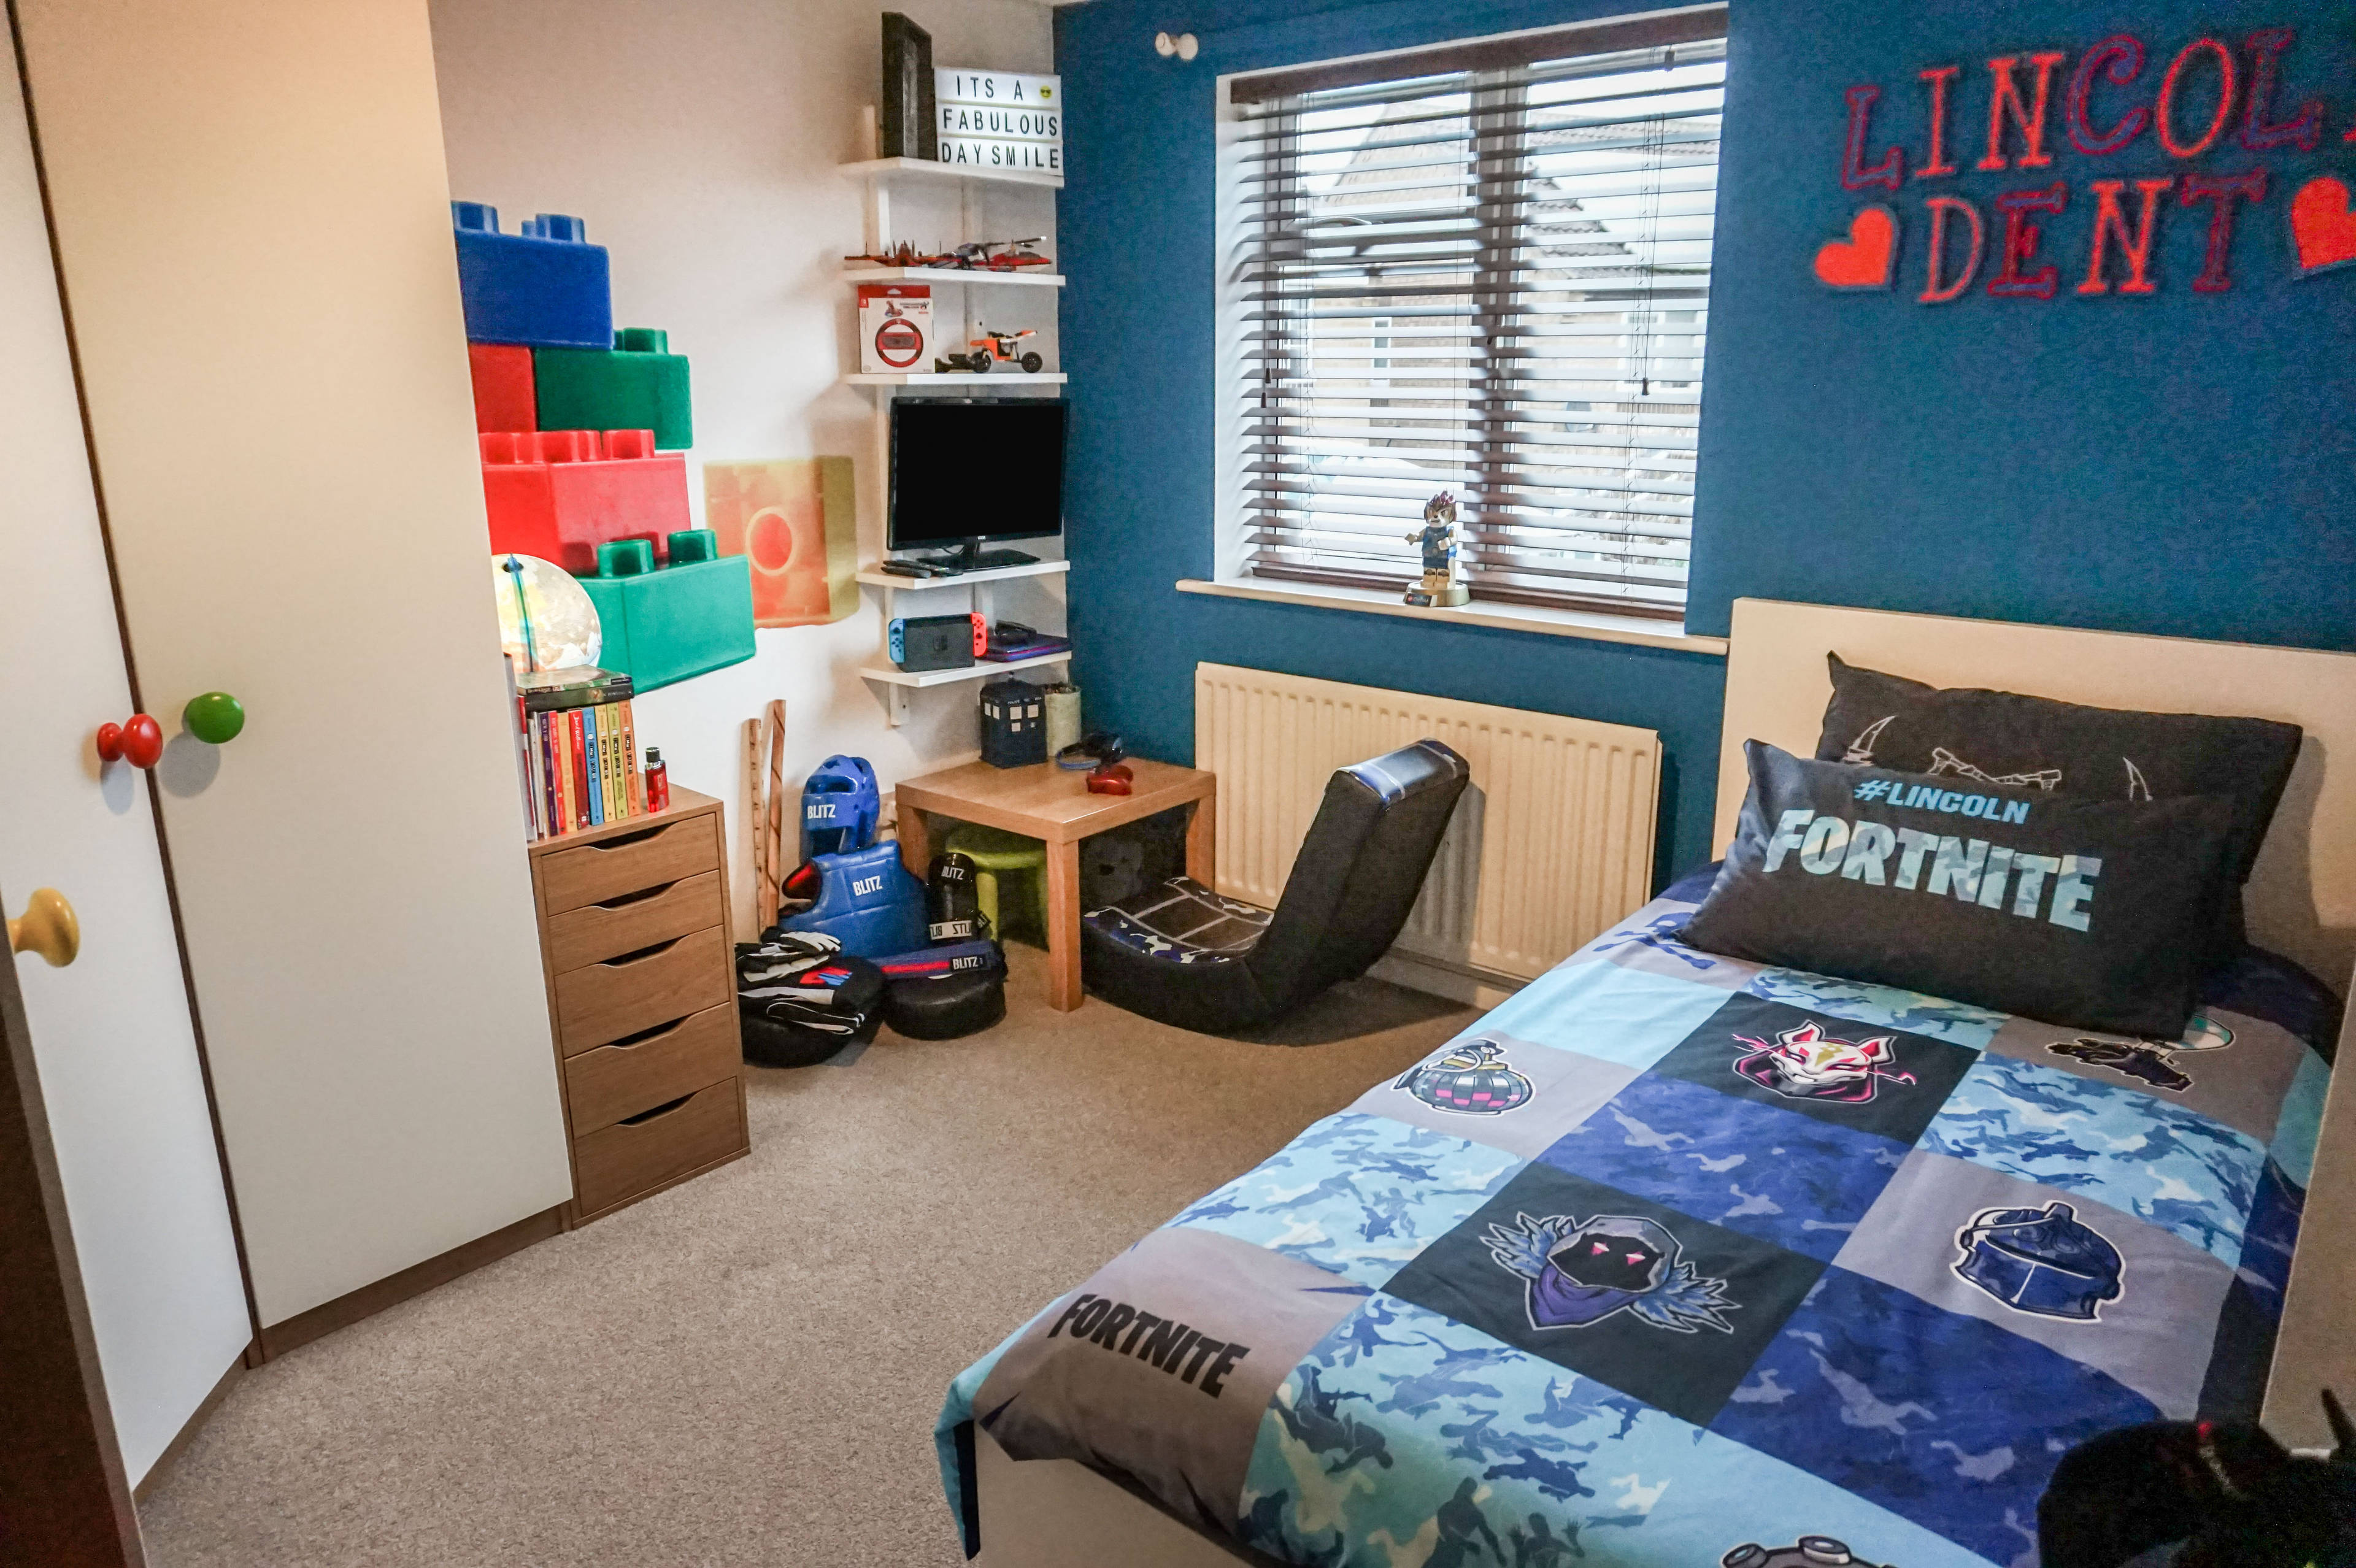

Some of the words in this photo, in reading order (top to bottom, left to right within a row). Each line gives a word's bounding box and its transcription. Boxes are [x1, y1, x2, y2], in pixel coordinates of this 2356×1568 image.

[957, 75, 995, 98] ITS
[1014, 80, 1023, 101] A
[943, 108, 1058, 136] FABULOUS
[1839, 27, 2356, 191] LINCOL
[942, 142, 982, 164] DAY
[991, 145, 1059, 169] SMILE
[1917, 166, 2269, 305] DENT
[807, 804, 836, 820] BLITZ
[1854, 778, 2030, 825] #LINCOLN
[941, 866, 964, 880] BLITZ
[1762, 809, 2102, 932] FORTNITE
[852, 875, 883, 897] BLITZ
[952, 956, 979, 970] BLITZ
[1047, 1293, 1252, 1400] FORTNITE
